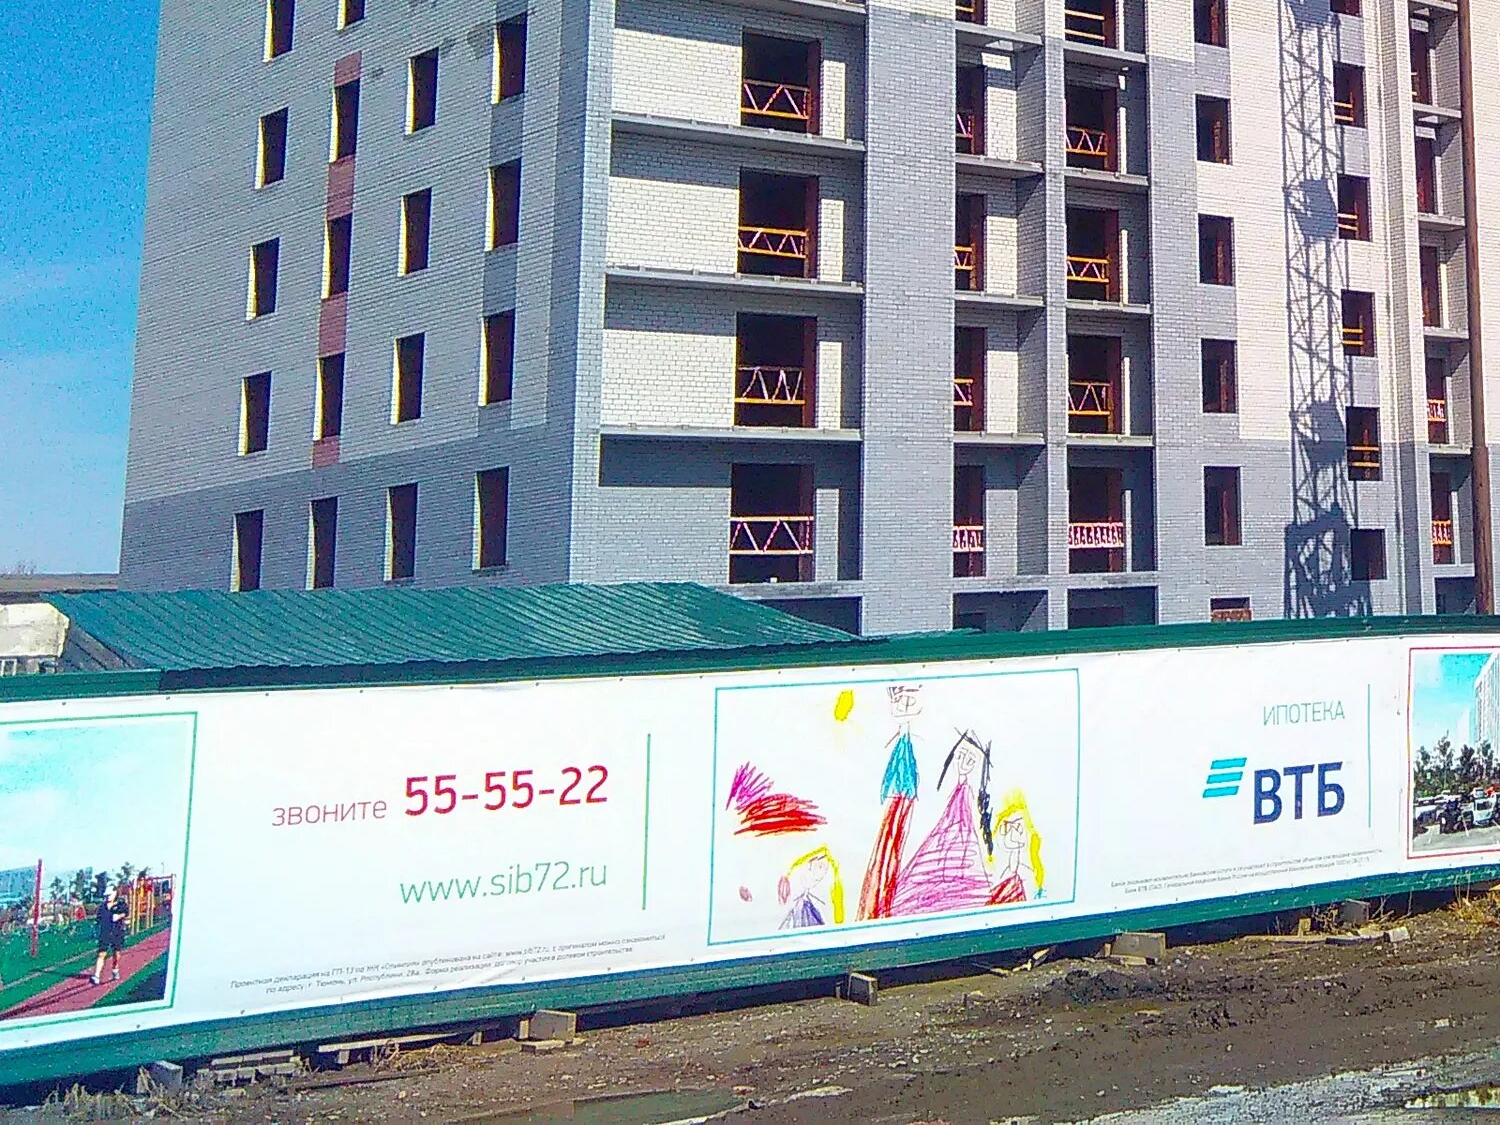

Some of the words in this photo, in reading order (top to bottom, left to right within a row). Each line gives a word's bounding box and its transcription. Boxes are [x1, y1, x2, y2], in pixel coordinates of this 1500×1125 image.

[1263, 699, 1346, 727] ИПОТЕКА
[271, 800, 387, 827] звоните
[404, 764, 609, 817] 55-55-22
[1253, 760, 1345, 825] ВТБ
[399, 860, 608, 905] www.sib72.ru
